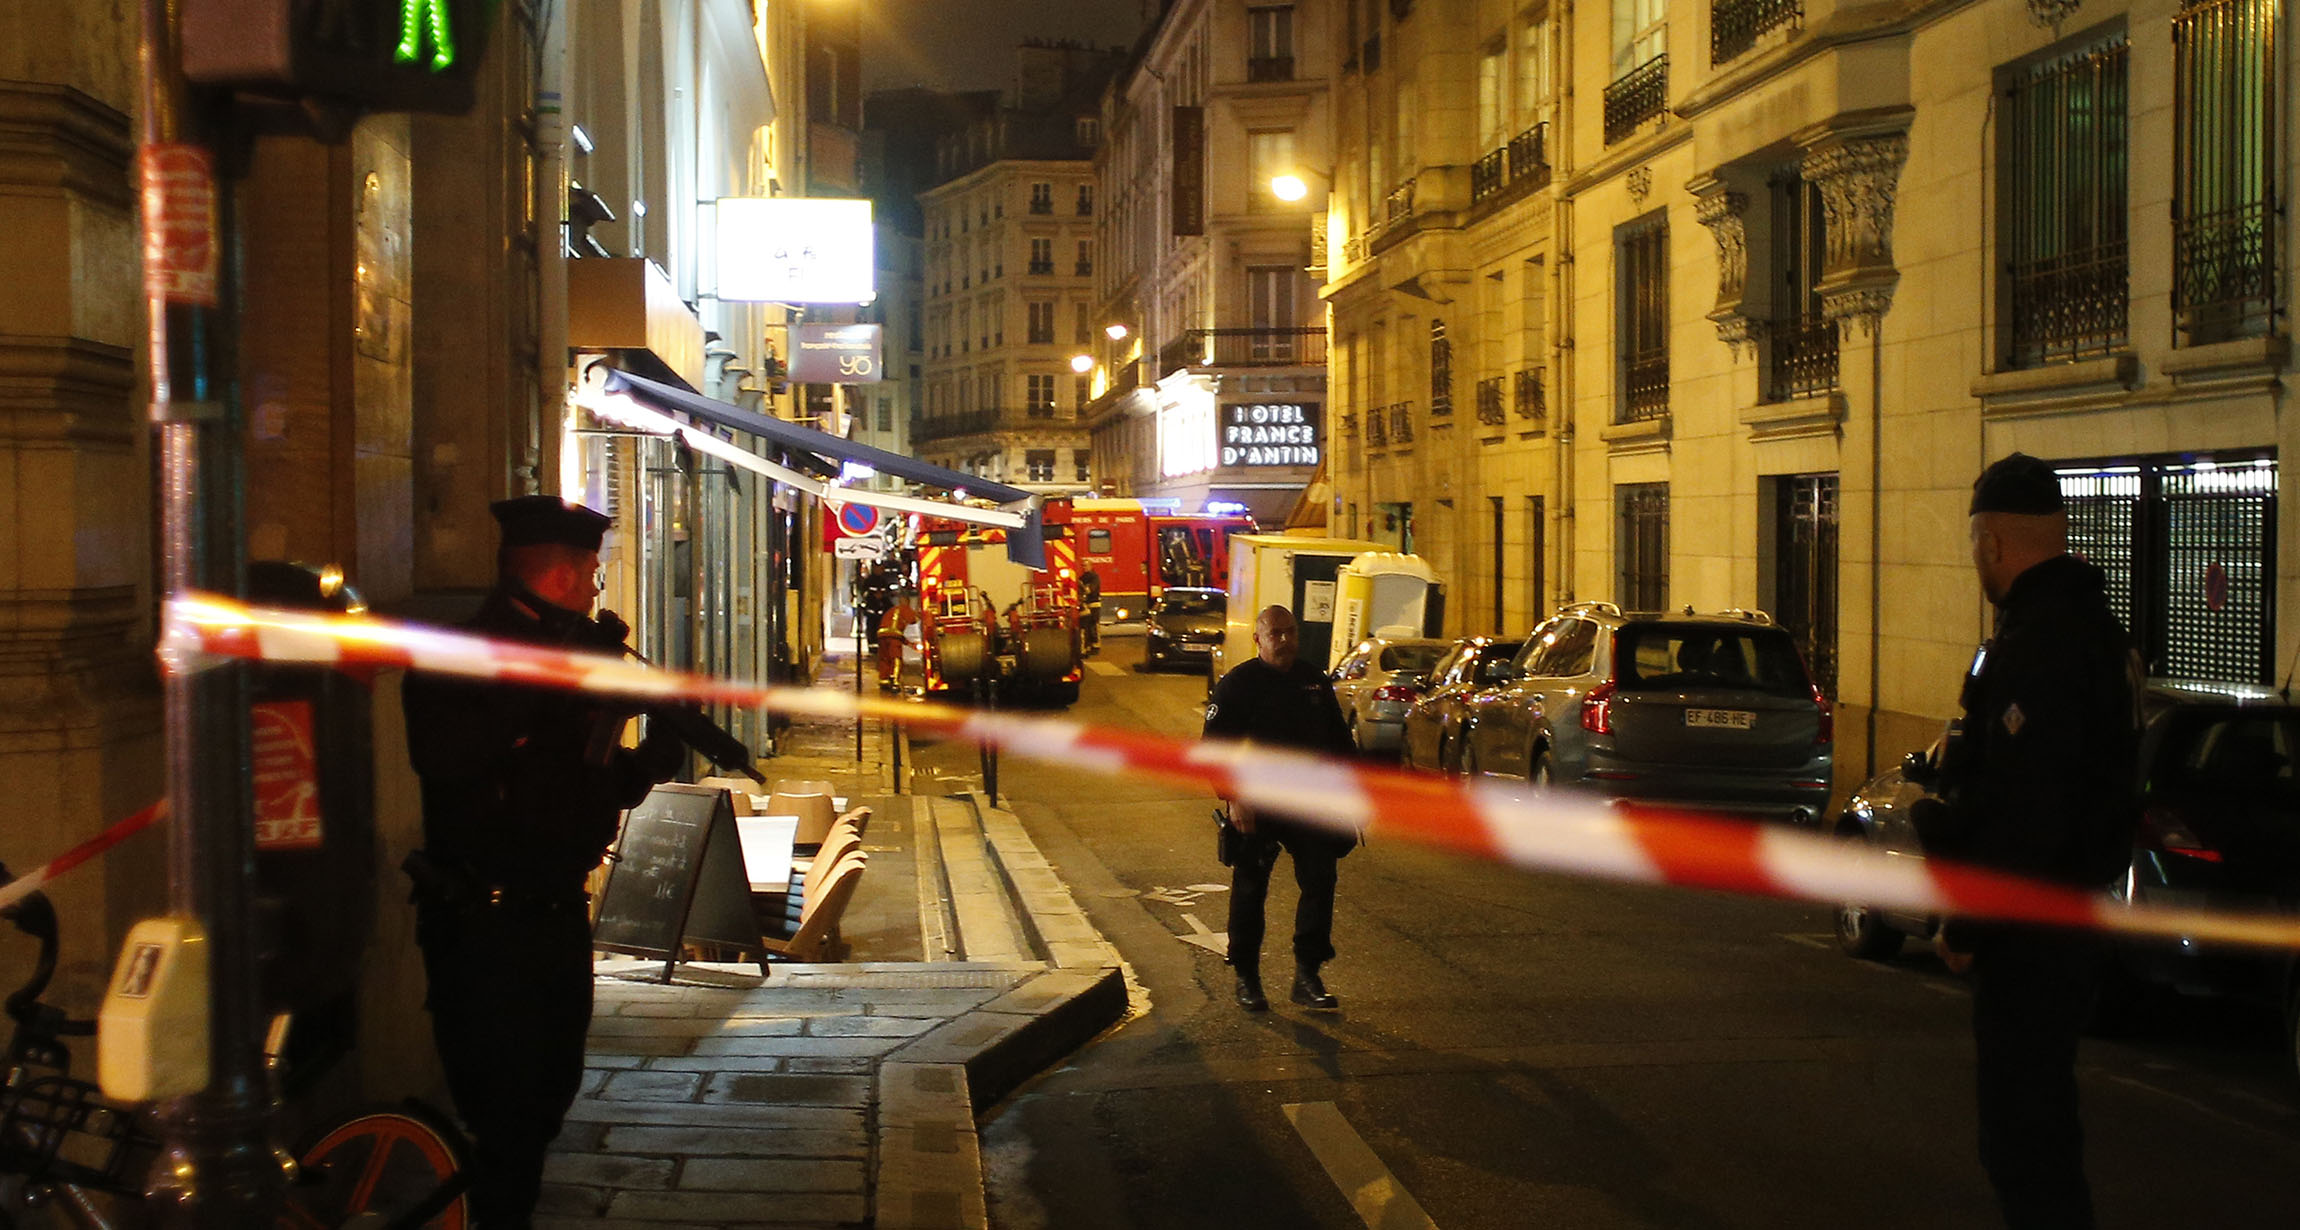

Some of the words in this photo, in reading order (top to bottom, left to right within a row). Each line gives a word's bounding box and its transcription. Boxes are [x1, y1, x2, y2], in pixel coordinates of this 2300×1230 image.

[1234, 405, 1304, 423] HOTEL
[1226, 425, 1313, 443] FRANCE
[1222, 446, 1318, 465] D'ANTIN
